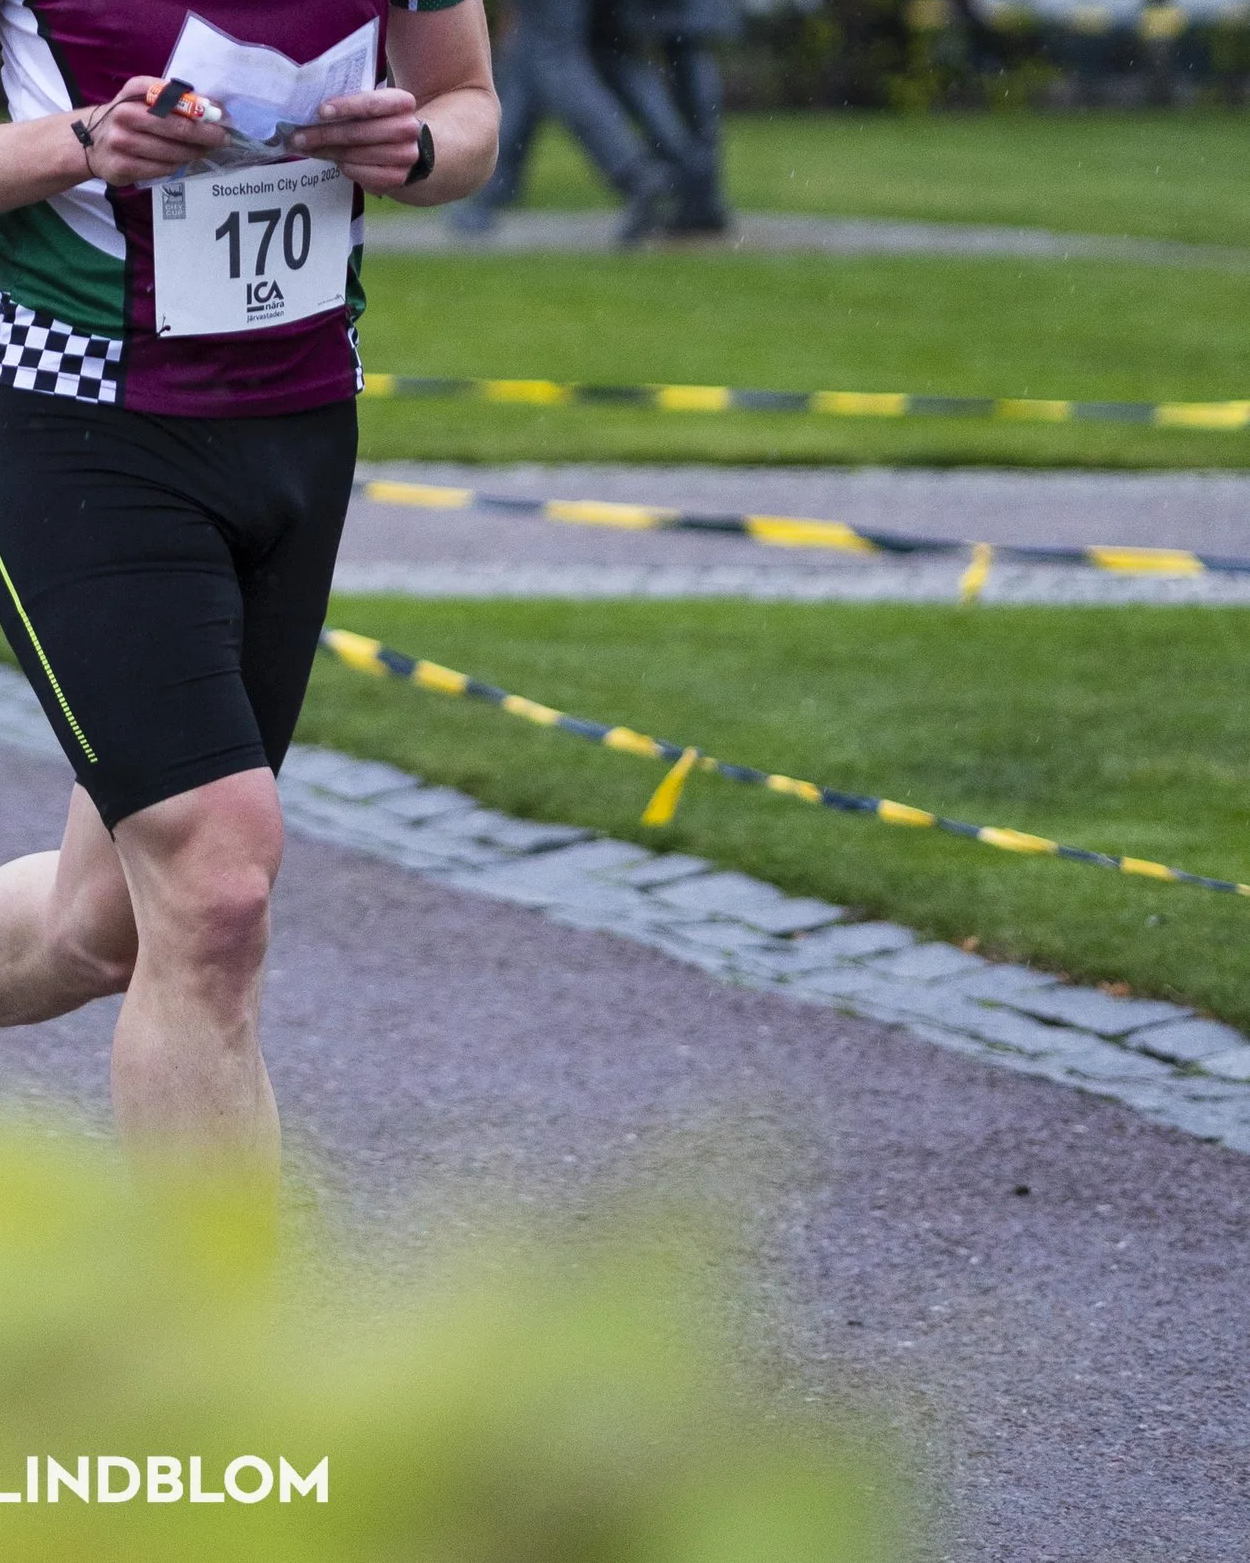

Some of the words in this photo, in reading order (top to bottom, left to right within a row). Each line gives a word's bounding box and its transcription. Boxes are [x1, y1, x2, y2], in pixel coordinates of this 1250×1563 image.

[212, 181, 274, 197] Stockholm
[277, 178, 297, 192] City
[300, 174, 319, 187] Cup
[215, 202, 311, 279] 170
[246, 279, 284, 305] ICA
[265, 300, 285, 310] nära
